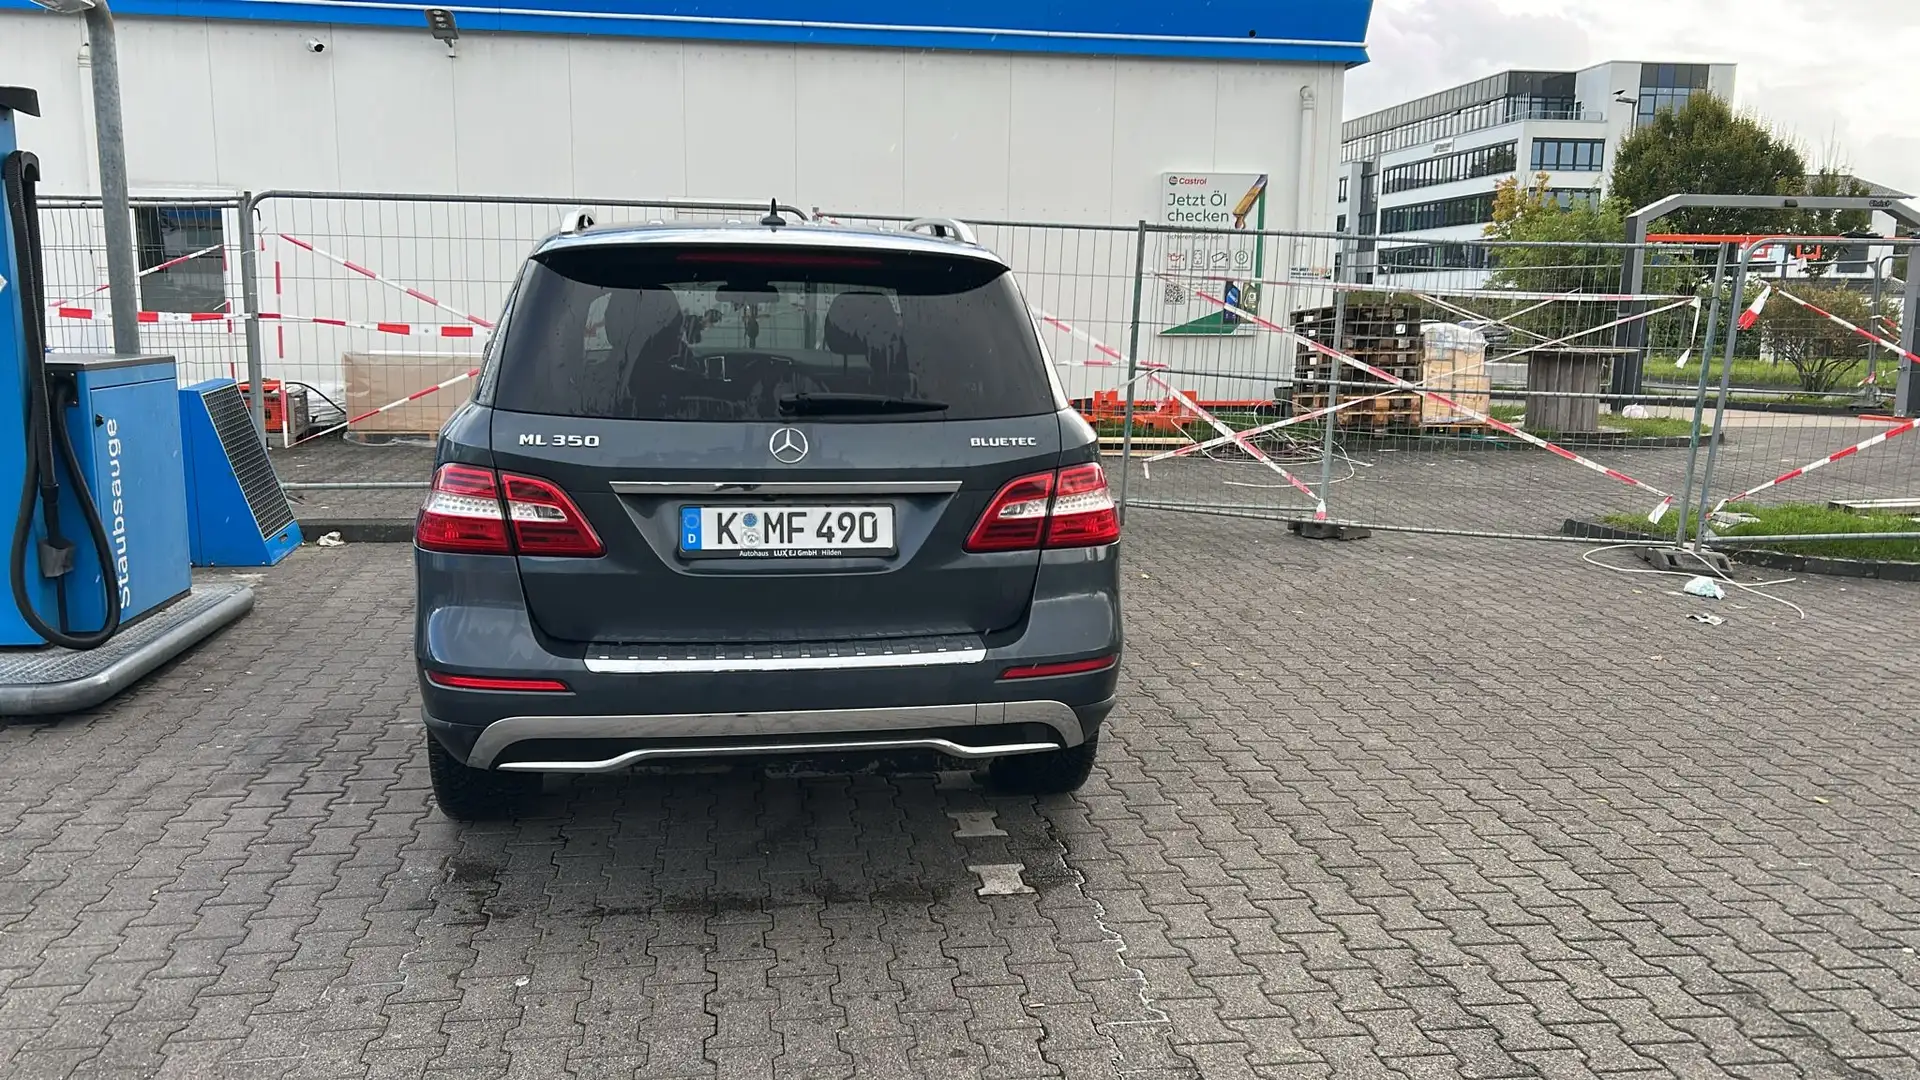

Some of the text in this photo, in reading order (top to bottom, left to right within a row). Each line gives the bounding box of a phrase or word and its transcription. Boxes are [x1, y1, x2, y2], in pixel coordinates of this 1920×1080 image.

[1178, 177, 1208, 185] Castrol
[1167, 190, 1227, 207] Jetzt Öl
[1167, 208, 1229, 222] checken
[519, 433, 600, 448] ML 350
[969, 436, 1037, 447] BLUETEC
[107, 418, 131, 609] Staubsauge
[717, 511, 879, 545] K MF 490
[687, 533, 697, 544] D
[797, 549, 818, 557] GmbH
